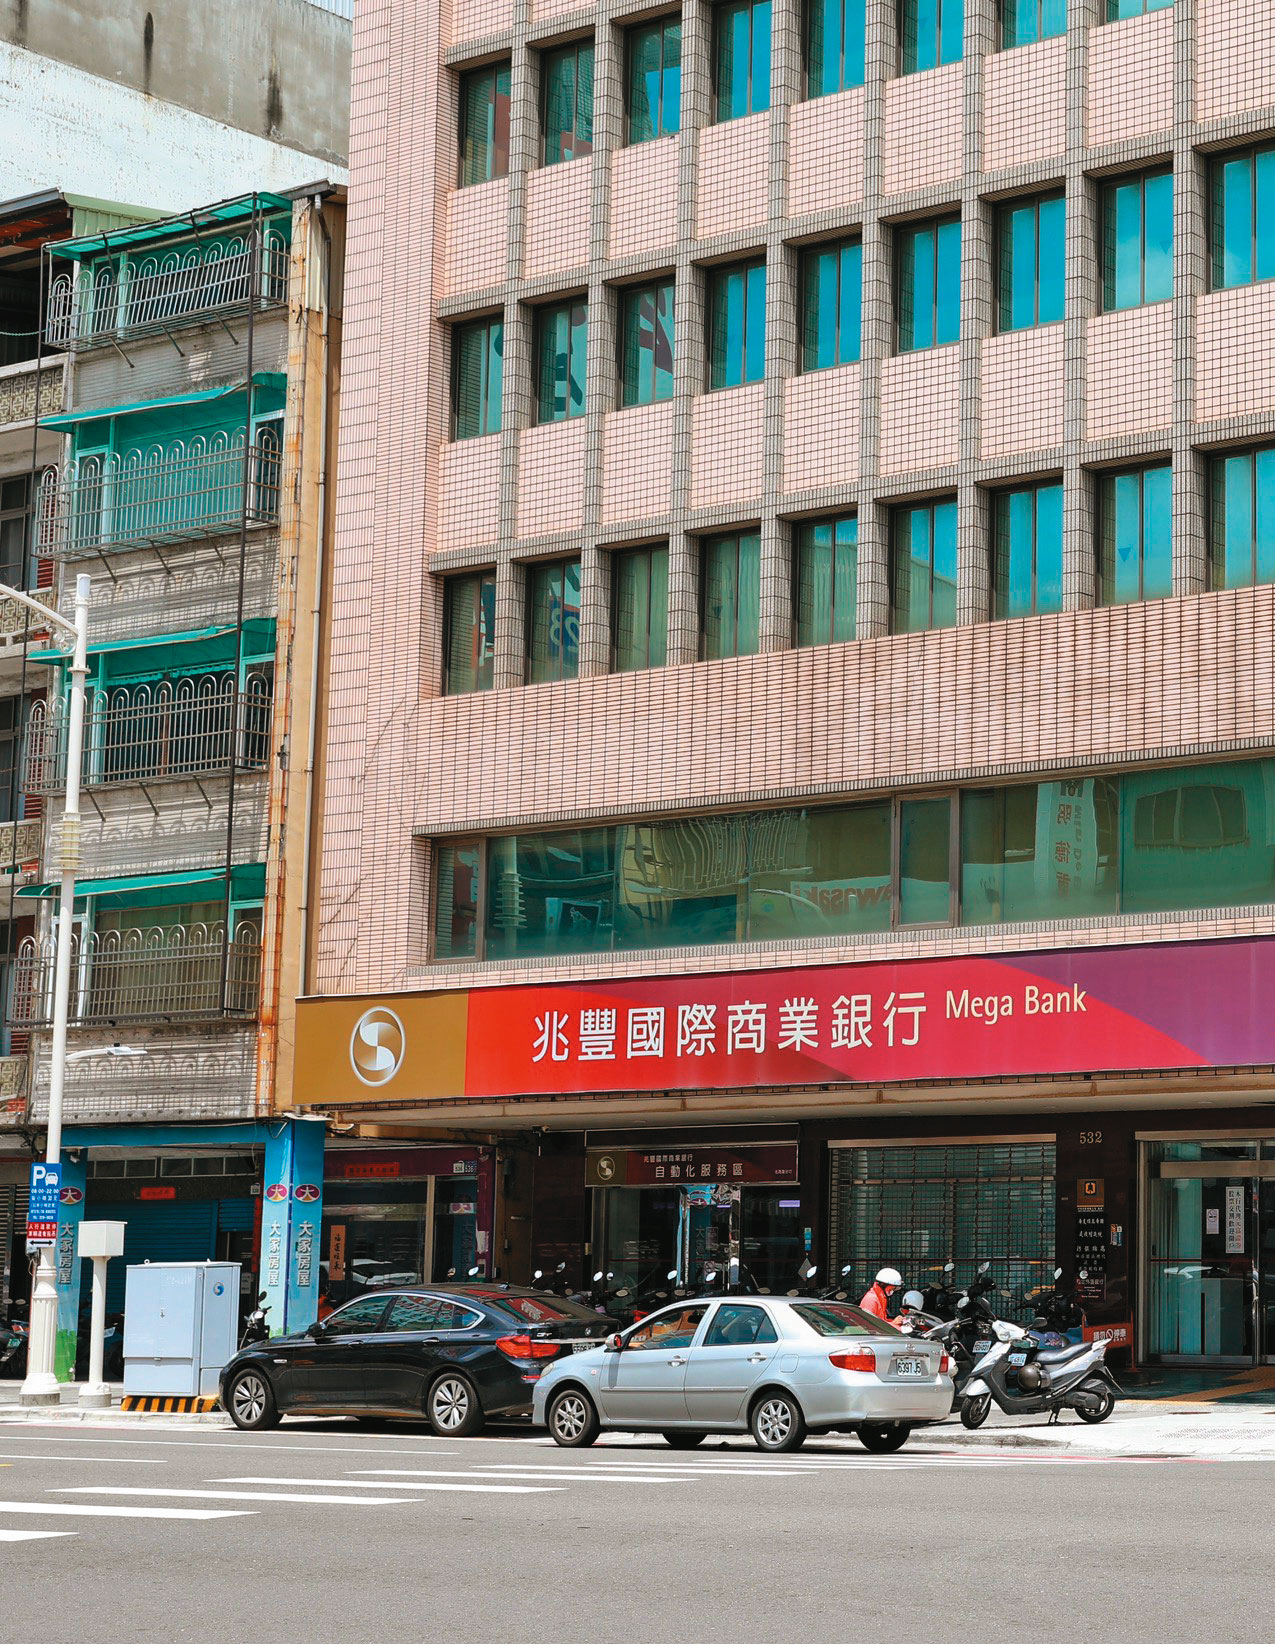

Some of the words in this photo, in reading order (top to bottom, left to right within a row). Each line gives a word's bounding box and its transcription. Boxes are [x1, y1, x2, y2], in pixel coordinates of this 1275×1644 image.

[945, 989, 1015, 1020] Mega
[1025, 983, 1087, 1015] Bank
[532, 990, 927, 1064] 兆豐國際商業銀行
[1080, 1131, 1103, 1144] 532
[32, 1166, 46, 1187] P
[655, 1163, 743, 1178] 自動化服務區
[59, 1222, 74, 1285] 大家房屋
[268, 1220, 281, 1287] 大家房屋
[297, 1220, 313, 1287] 大家房屋
